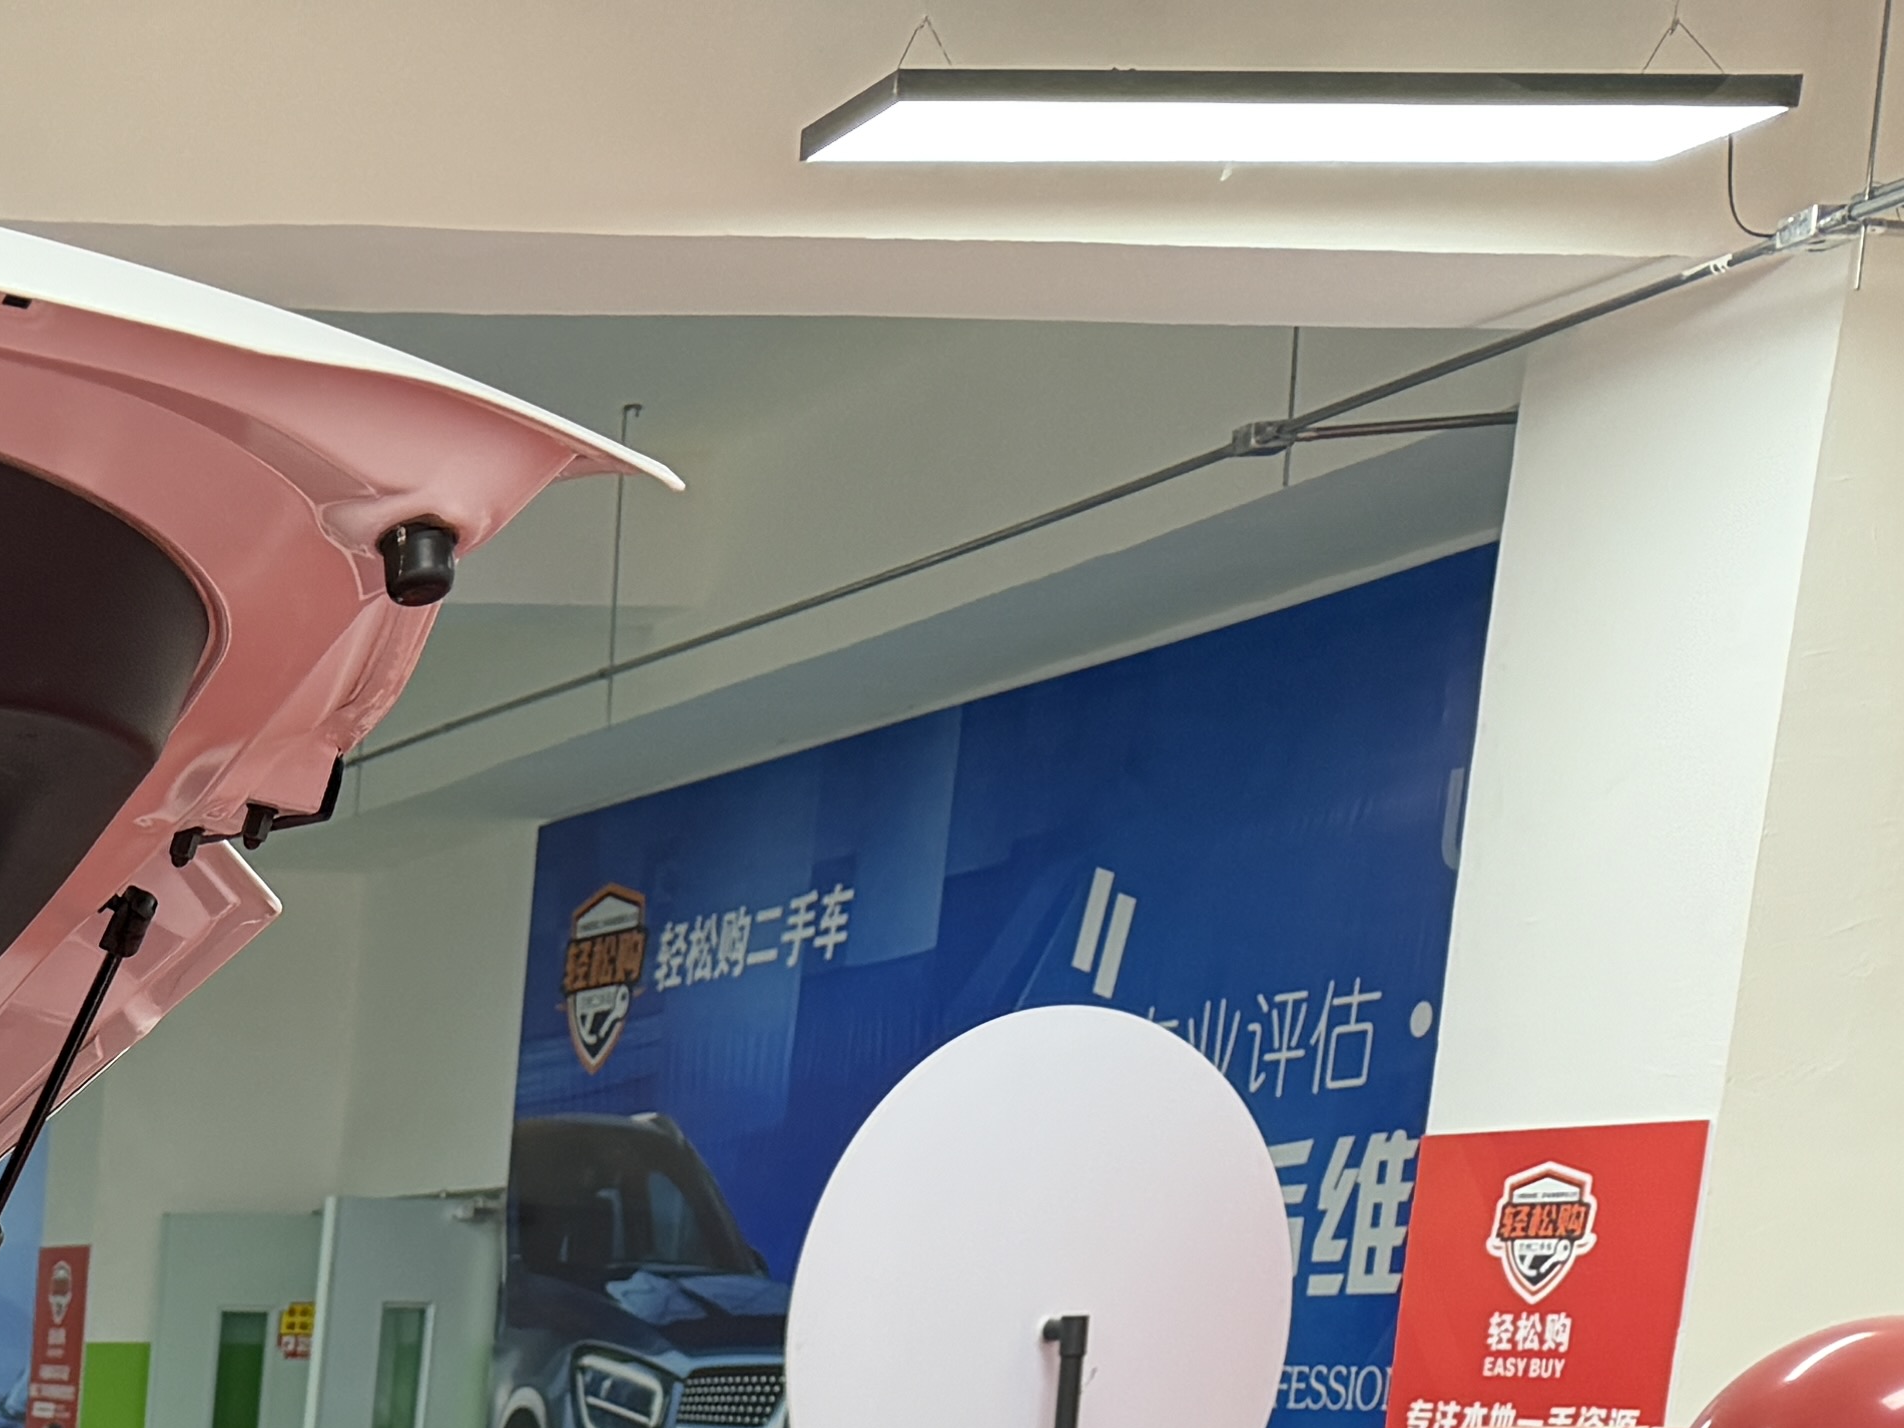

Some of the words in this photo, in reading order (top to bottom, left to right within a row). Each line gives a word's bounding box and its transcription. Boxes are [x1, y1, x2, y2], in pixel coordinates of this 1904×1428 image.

[654, 883, 855, 992] 轻松购二手车
[1148, 977, 1382, 1097] 业评估
[1500, 1204, 1586, 1238] 轻松购
[1487, 1311, 1572, 1353] 轻松购
[1482, 1357, 1528, 1377] EASY
[1529, 1358, 1565, 1379] BUY
